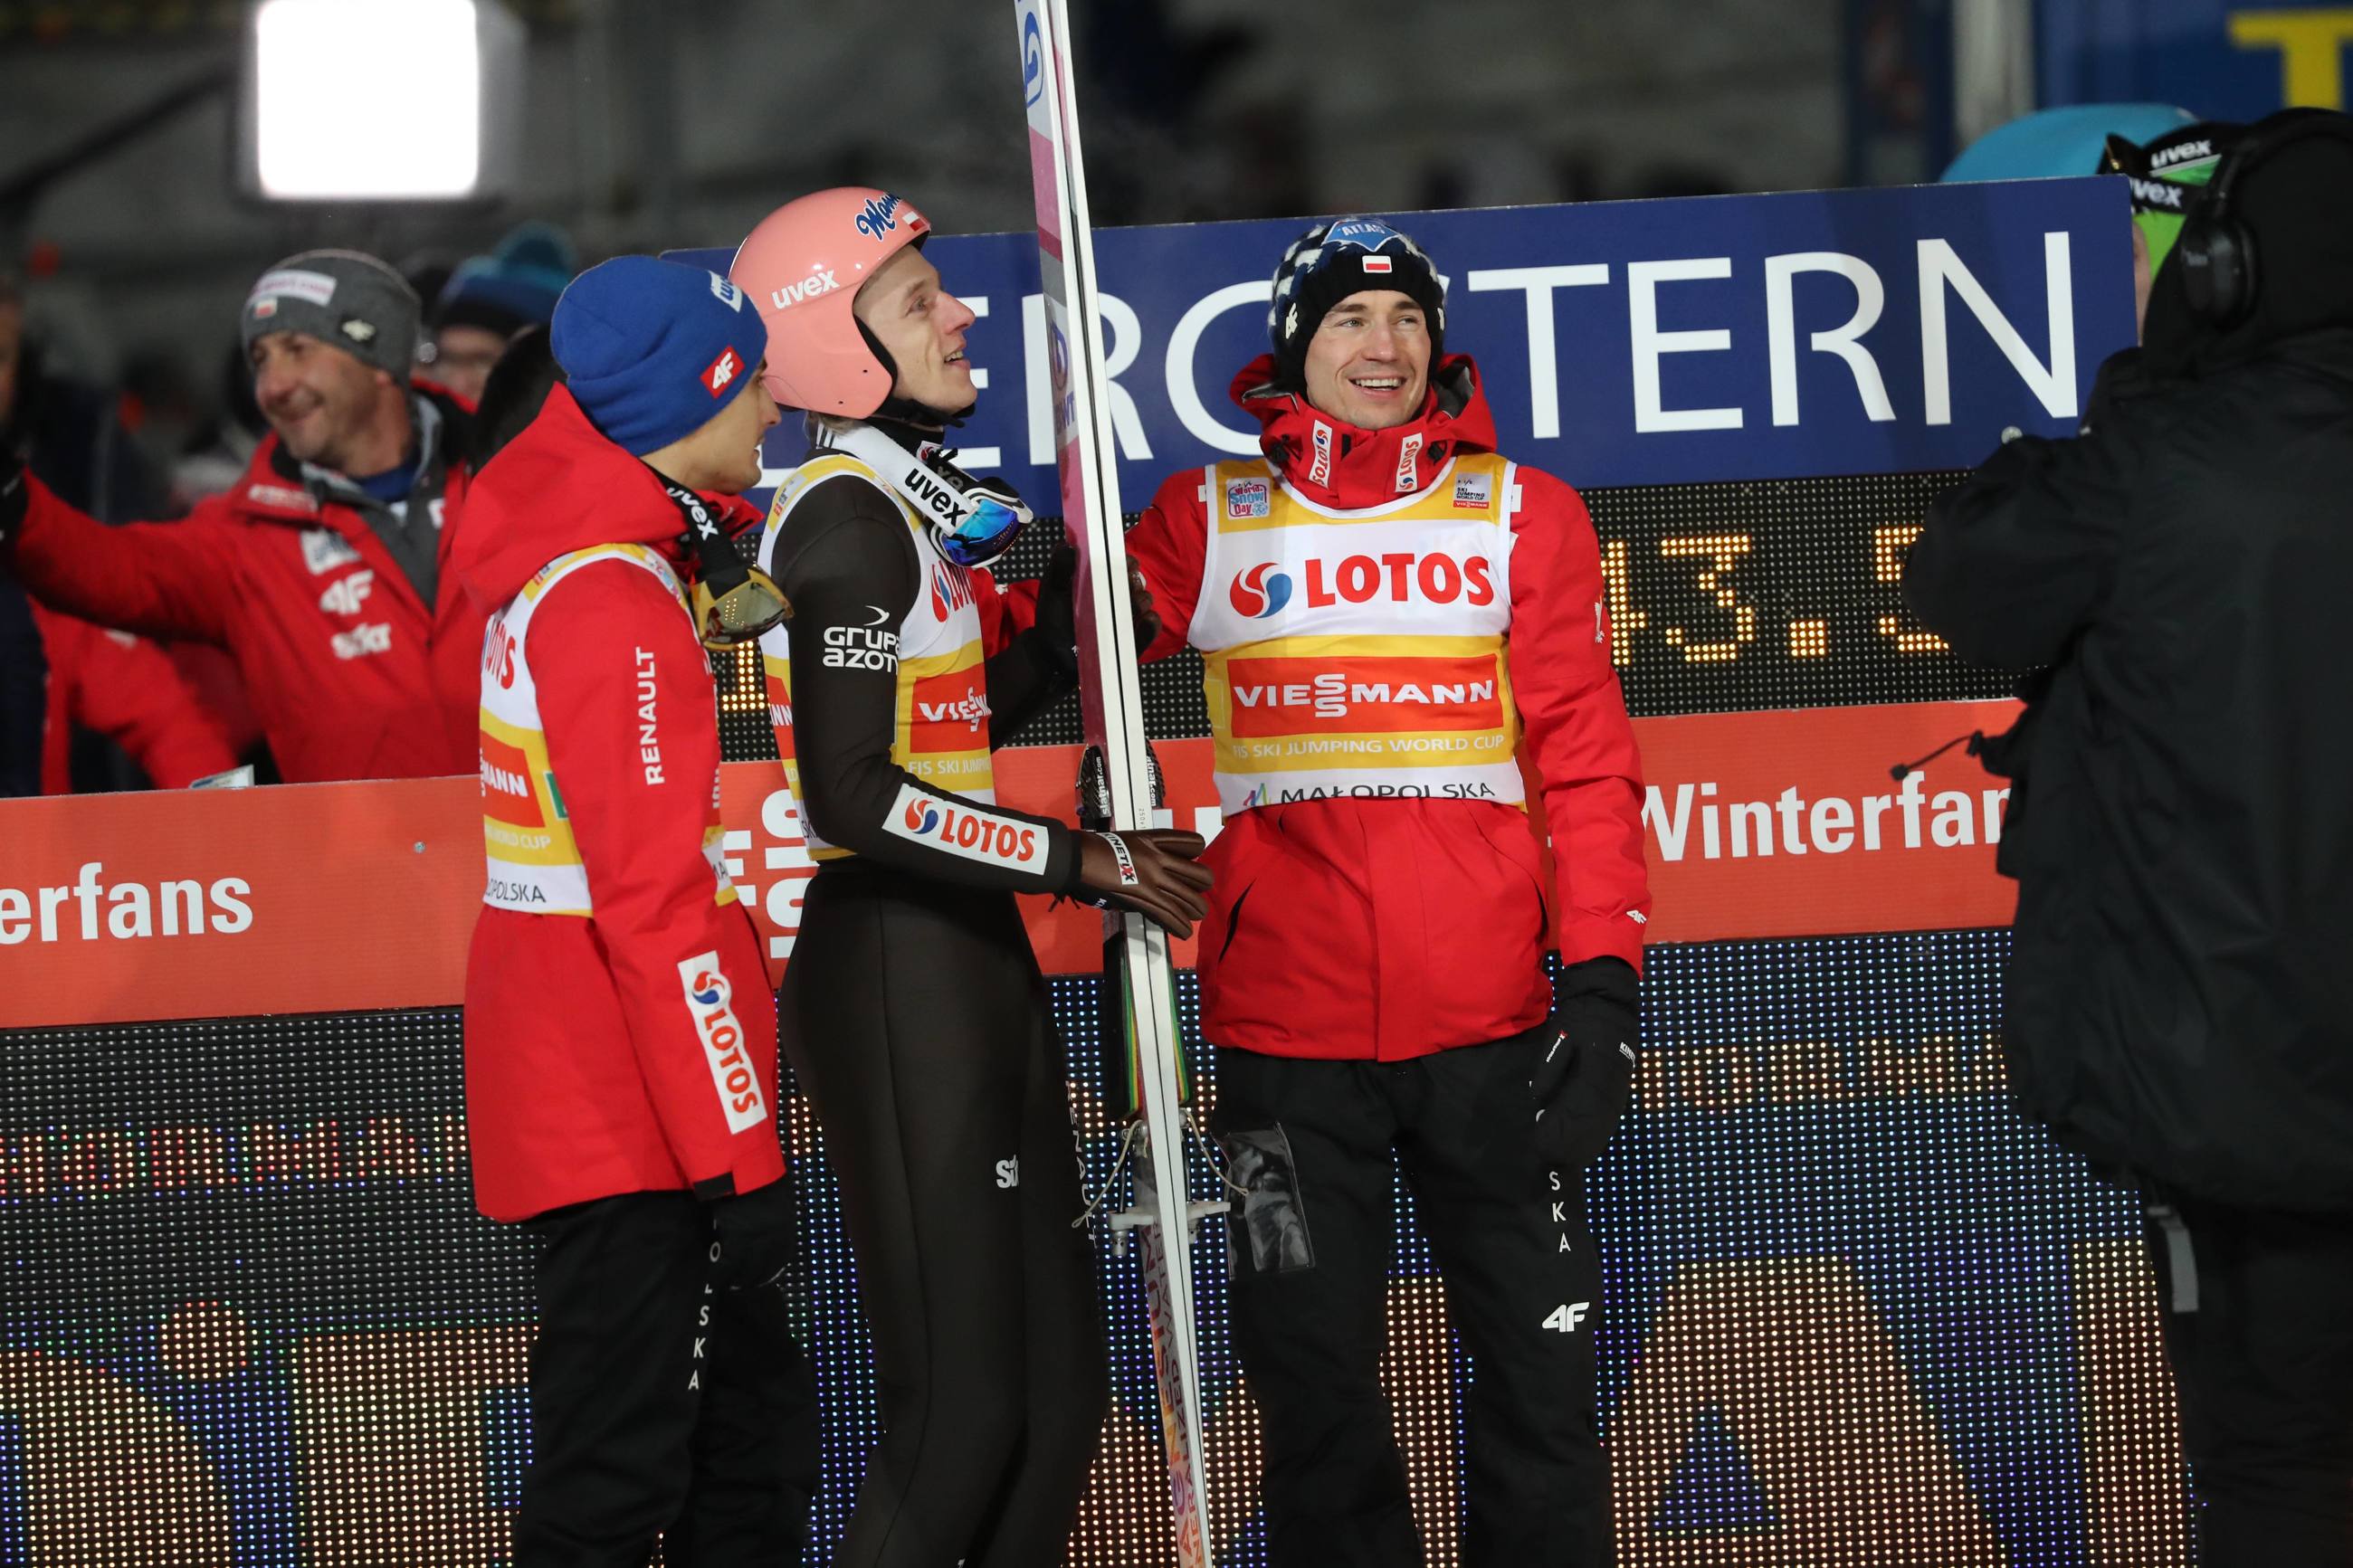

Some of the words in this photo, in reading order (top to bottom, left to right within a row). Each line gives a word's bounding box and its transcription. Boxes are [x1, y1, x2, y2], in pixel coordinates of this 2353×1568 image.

[2151, 139, 2212, 169] uvex
[2129, 179, 2184, 207] vex
[1342, 223, 1386, 236] ATLAS
[772, 271, 840, 309] uvex
[712, 352, 735, 389] 4F
[1312, 444, 1329, 485] LOTOS
[1400, 441, 1419, 476] LOTOS
[666, 488, 719, 541] uvex
[905, 468, 968, 527] uvex
[1231, 492, 1264, 505] Snow
[1234, 504, 1253, 515] Day
[1305, 552, 1494, 607] LOTOS
[919, 686, 992, 733] VIESSM
[1234, 673, 1493, 717] VIESSMANN
[635, 647, 665, 784] RENAULT
[1253, 744, 1281, 757] SKI
[1284, 738, 1383, 756] JUMPING
[1389, 736, 1468, 753] WORLD
[1473, 735, 1504, 750] CUP
[908, 760, 933, 776] FIS
[937, 758, 960, 774] SKI
[1096, 755, 1111, 816] slatnar.com
[519, 834, 551, 850] CUP
[939, 808, 1035, 862] LOTOS
[1625, 909, 1647, 925] 4F
[703, 1007, 759, 1115] LOTOS
[1541, 1301, 1590, 1333] 4F
[1139, 1223, 1195, 1568] AGNESIUM
